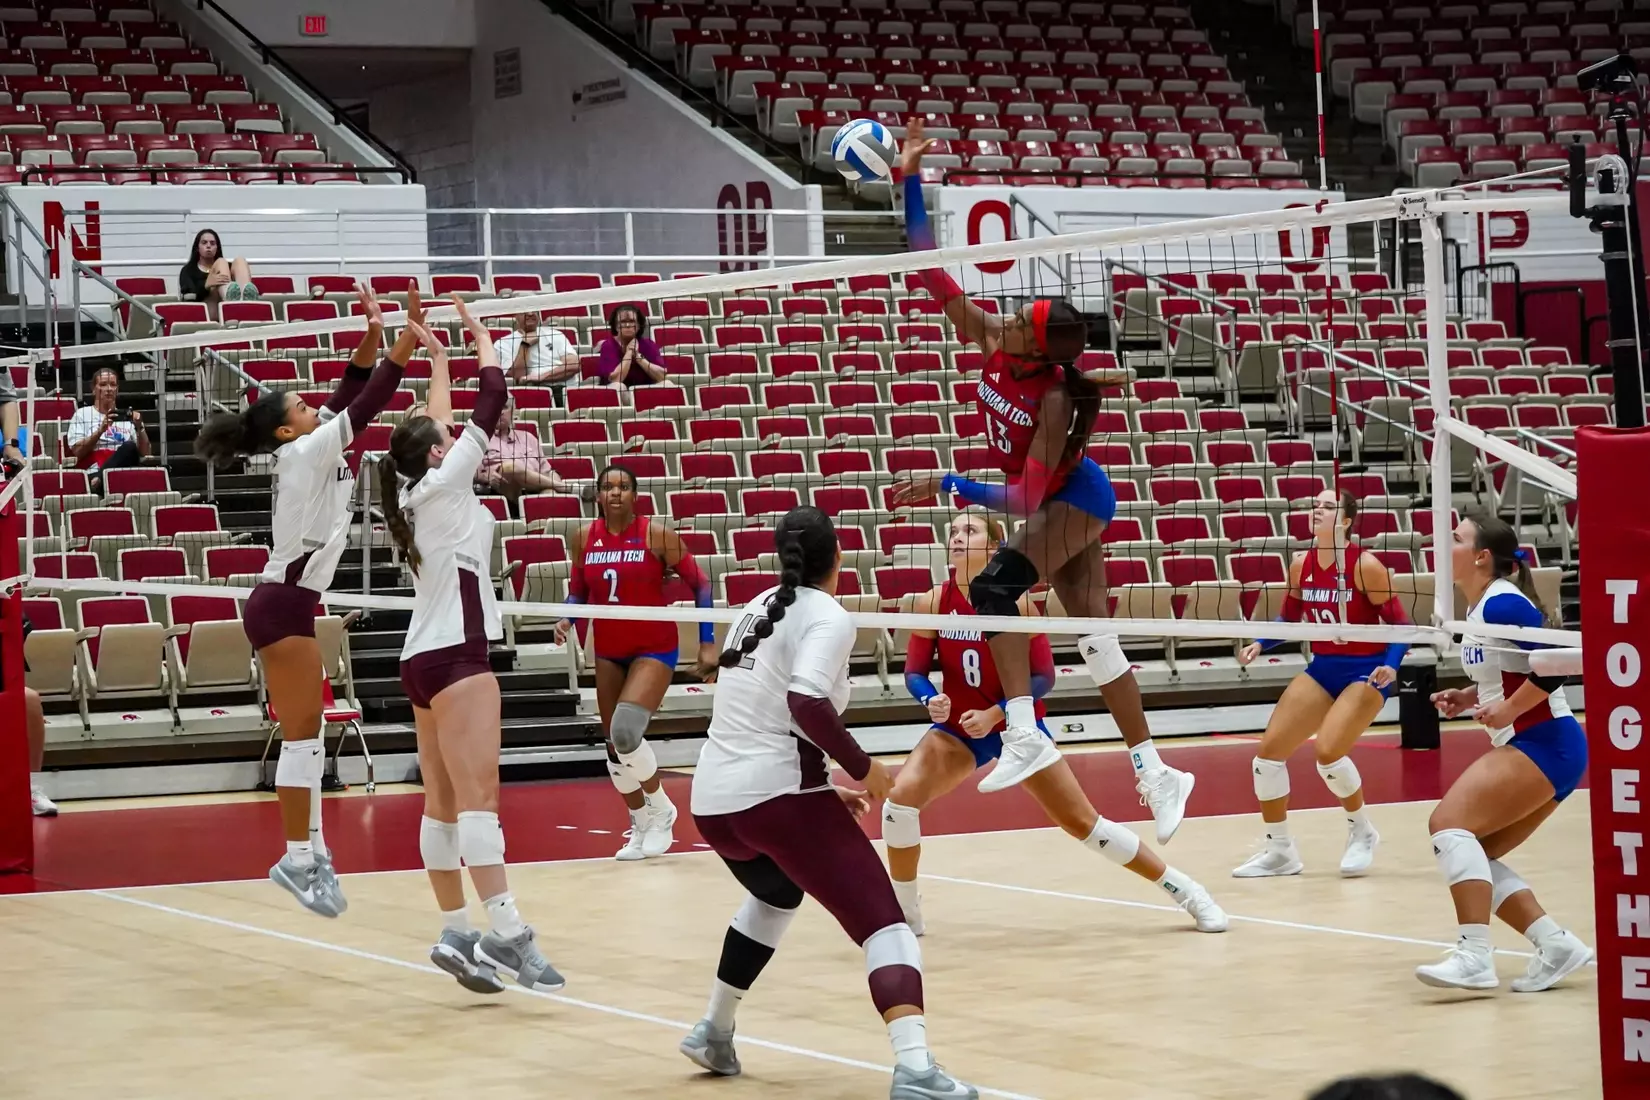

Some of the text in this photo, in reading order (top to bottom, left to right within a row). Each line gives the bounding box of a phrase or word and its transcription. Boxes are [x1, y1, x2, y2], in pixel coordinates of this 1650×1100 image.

[306, 17, 326, 33] EXIT
[44, 201, 103, 279] N
[836, 234, 845, 245] 11
[968, 200, 1017, 274] O
[985, 411, 1011, 455] 13
[585, 550, 645, 565] LOUISIANA TECH
[603, 569, 620, 602] 2
[962, 648, 981, 688] 8
[1605, 579, 1650, 1063] TOGETHER
